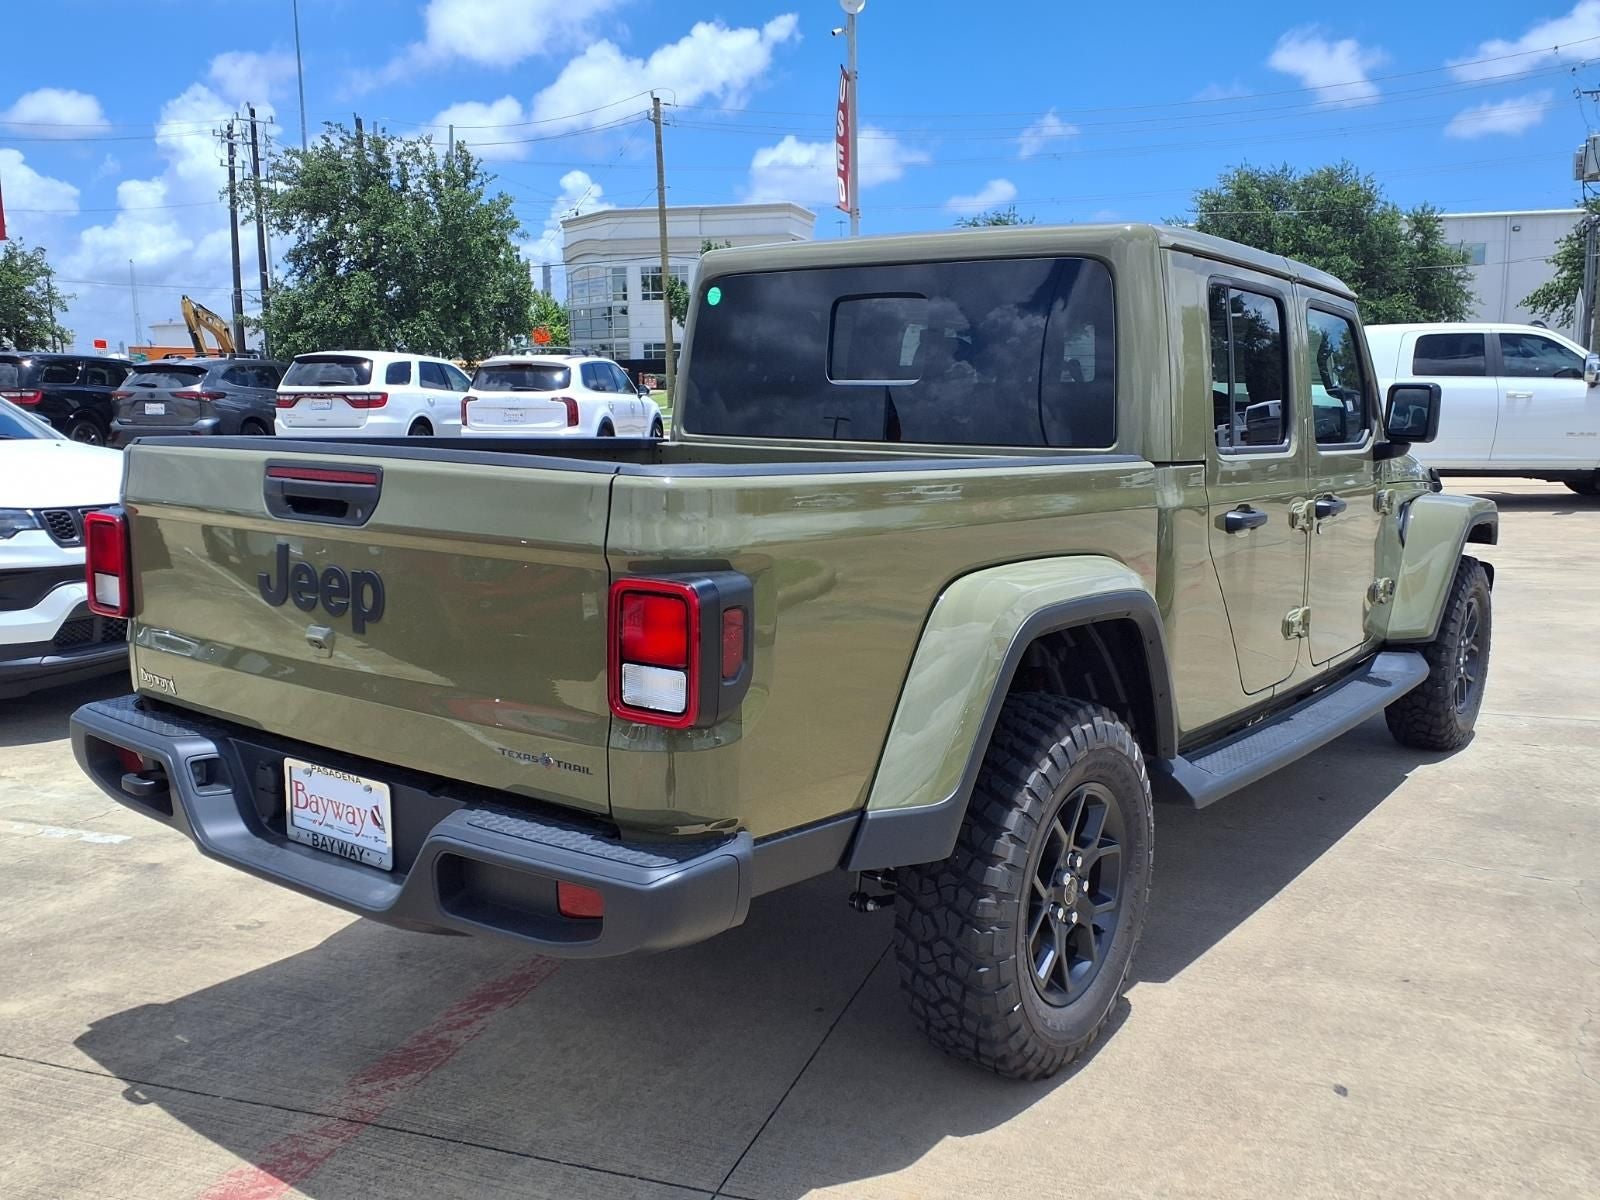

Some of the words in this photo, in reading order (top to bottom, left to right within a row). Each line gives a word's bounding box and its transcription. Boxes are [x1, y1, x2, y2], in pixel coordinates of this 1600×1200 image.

[837, 75, 847, 203] USED
[257, 543, 385, 635] Jeep
[310, 764, 362, 785] PASADENA
[498, 747, 539, 763] TEXAS
[555, 760, 594, 776] TRAIL
[292, 780, 367, 837] Bayway
[311, 834, 364, 861] BAYWAY
